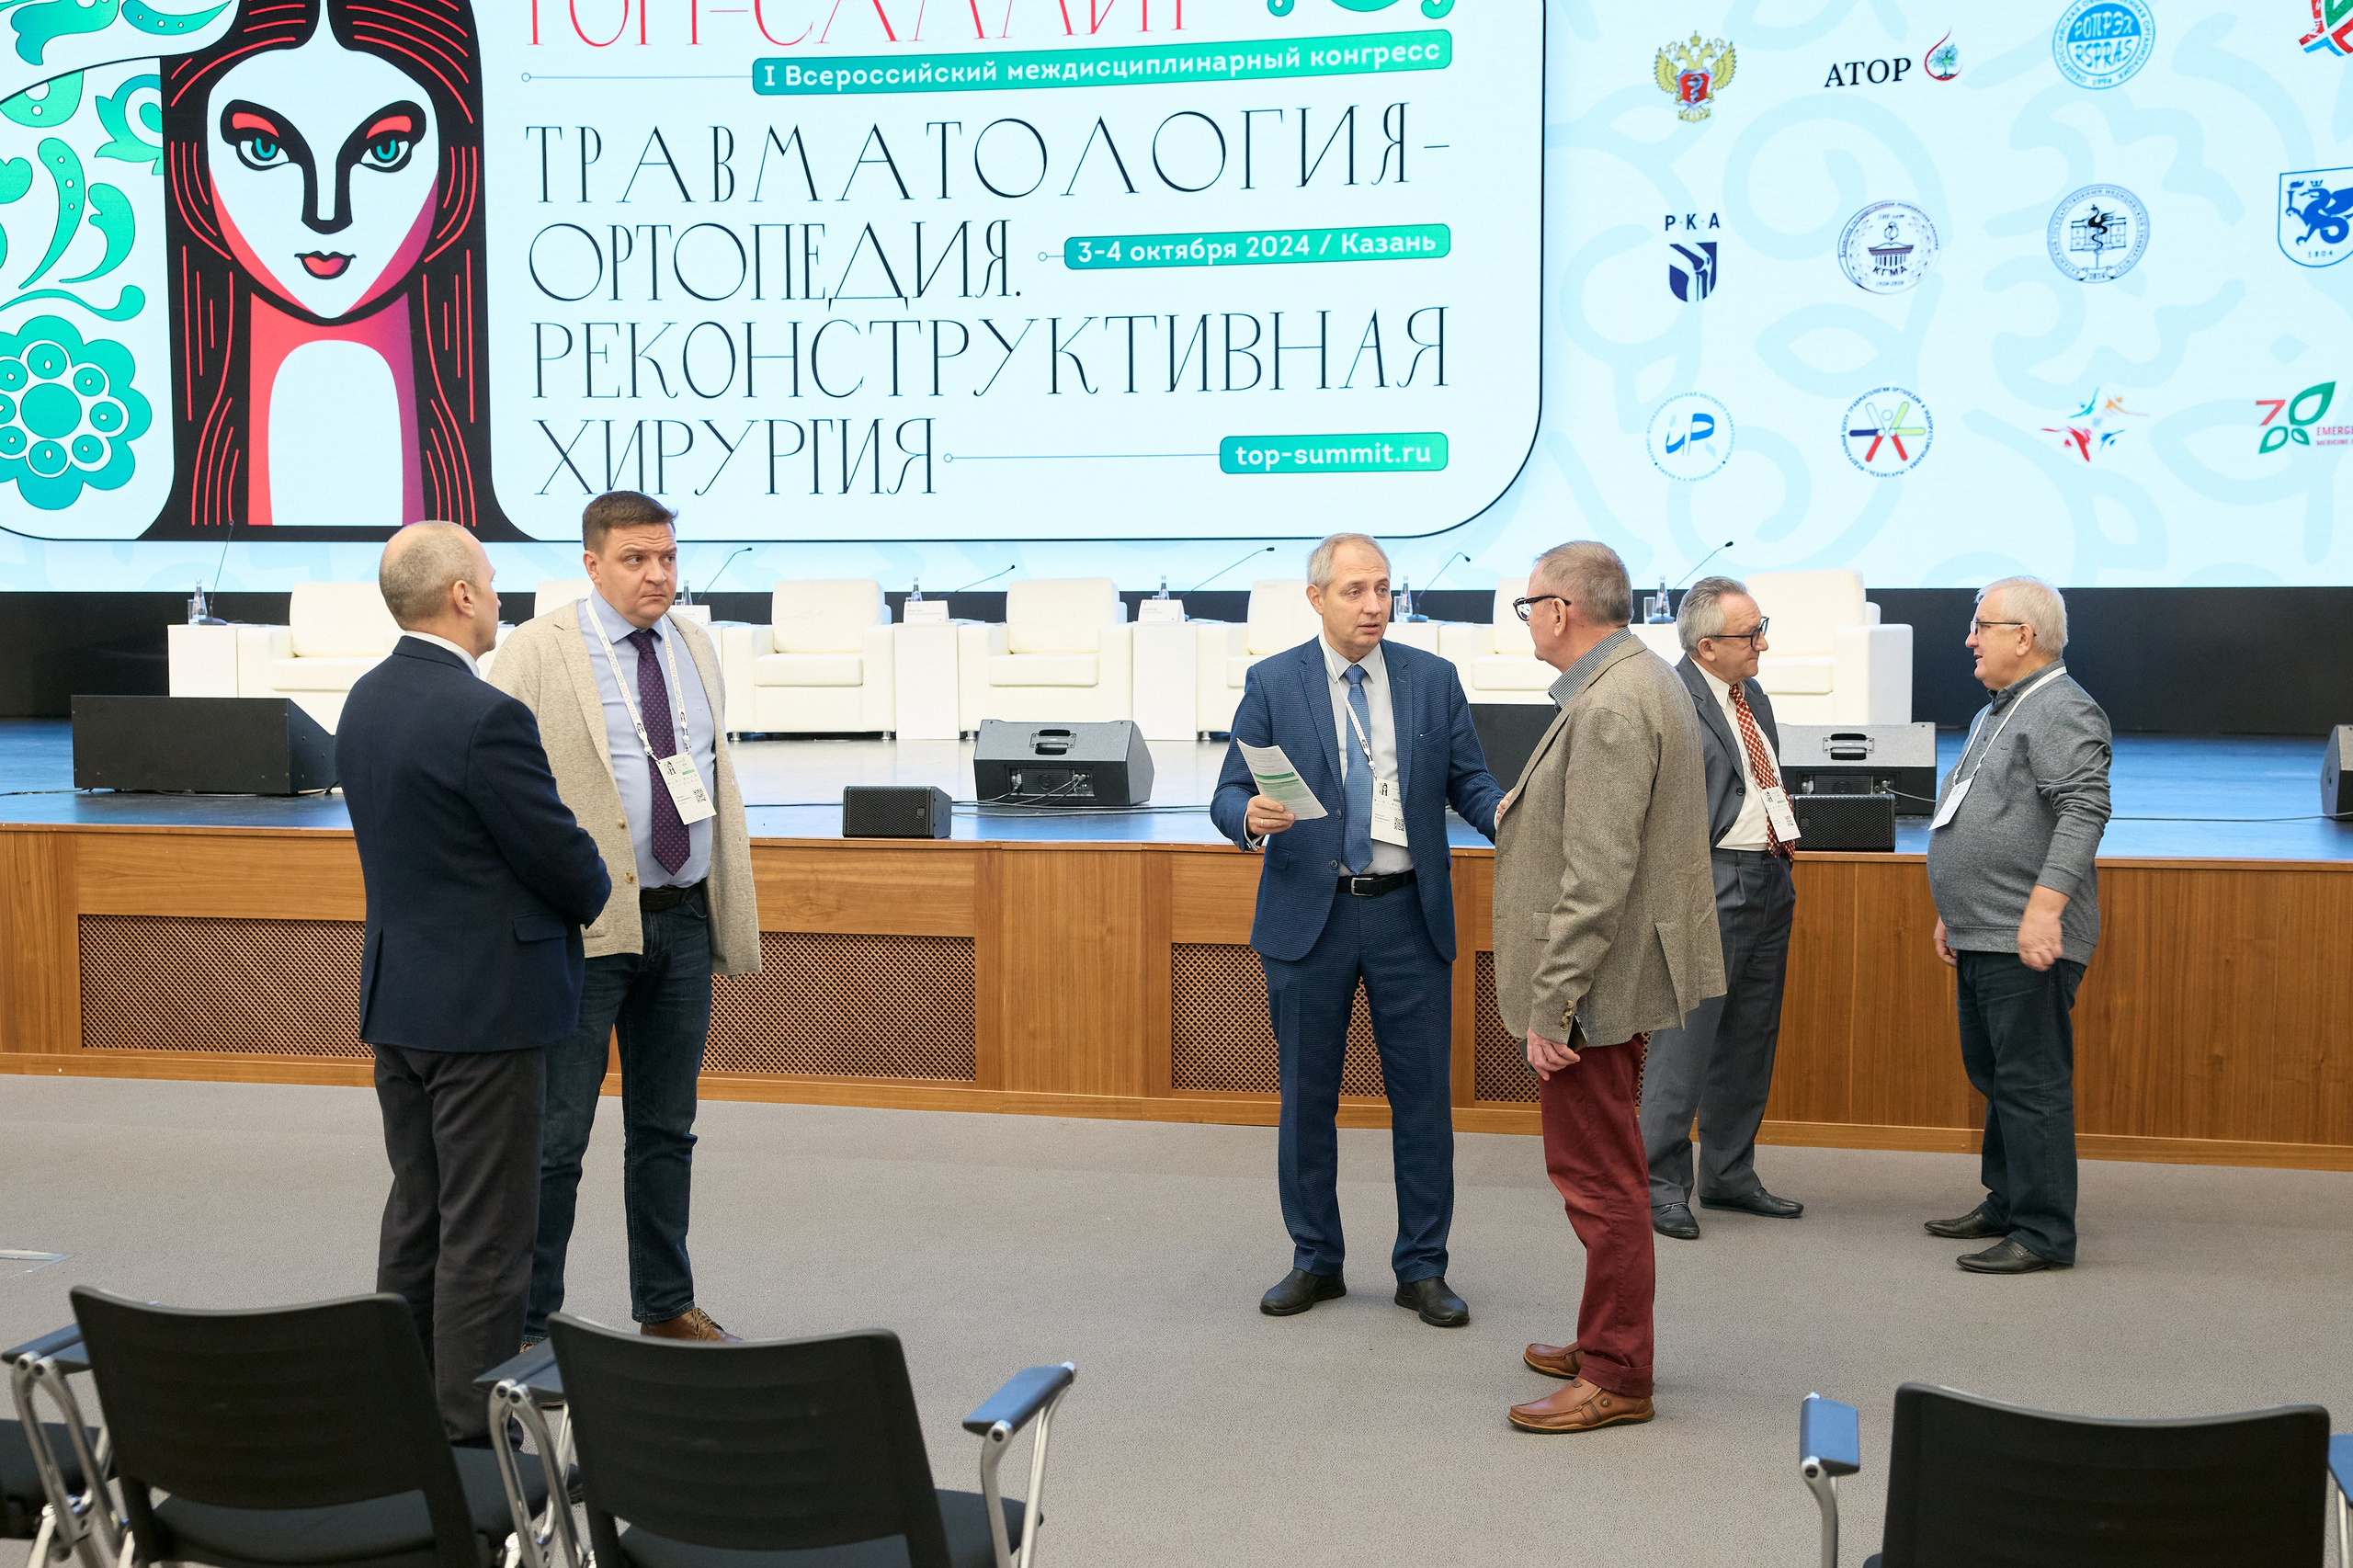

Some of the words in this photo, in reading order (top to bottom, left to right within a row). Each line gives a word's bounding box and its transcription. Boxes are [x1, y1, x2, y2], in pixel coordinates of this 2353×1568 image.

[786, 61, 996, 92] Всероссийский
[1008, 46, 1300, 81] междисциплинарный
[1311, 40, 1440, 69] конгресс
[526, 102, 1450, 202] ТРАВМАТОЛОГИЯ-
[529, 219, 1021, 312] ОРТОПЕДИЯ.
[1077, 241, 1121, 262] 3-4
[1130, 238, 1237, 265] октября
[1245, 236, 1310, 257] 2024
[1319, 234, 1332, 256] /
[1341, 233, 1437, 255] Казань
[530, 306, 1449, 399] РЕКОНСТРУКТИВНАЯ
[533, 417, 937, 495] ХИРУРГИЯ
[1235, 443, 1431, 472] top-summit.ru
[2316, 426, 2353, 437] EMERG
